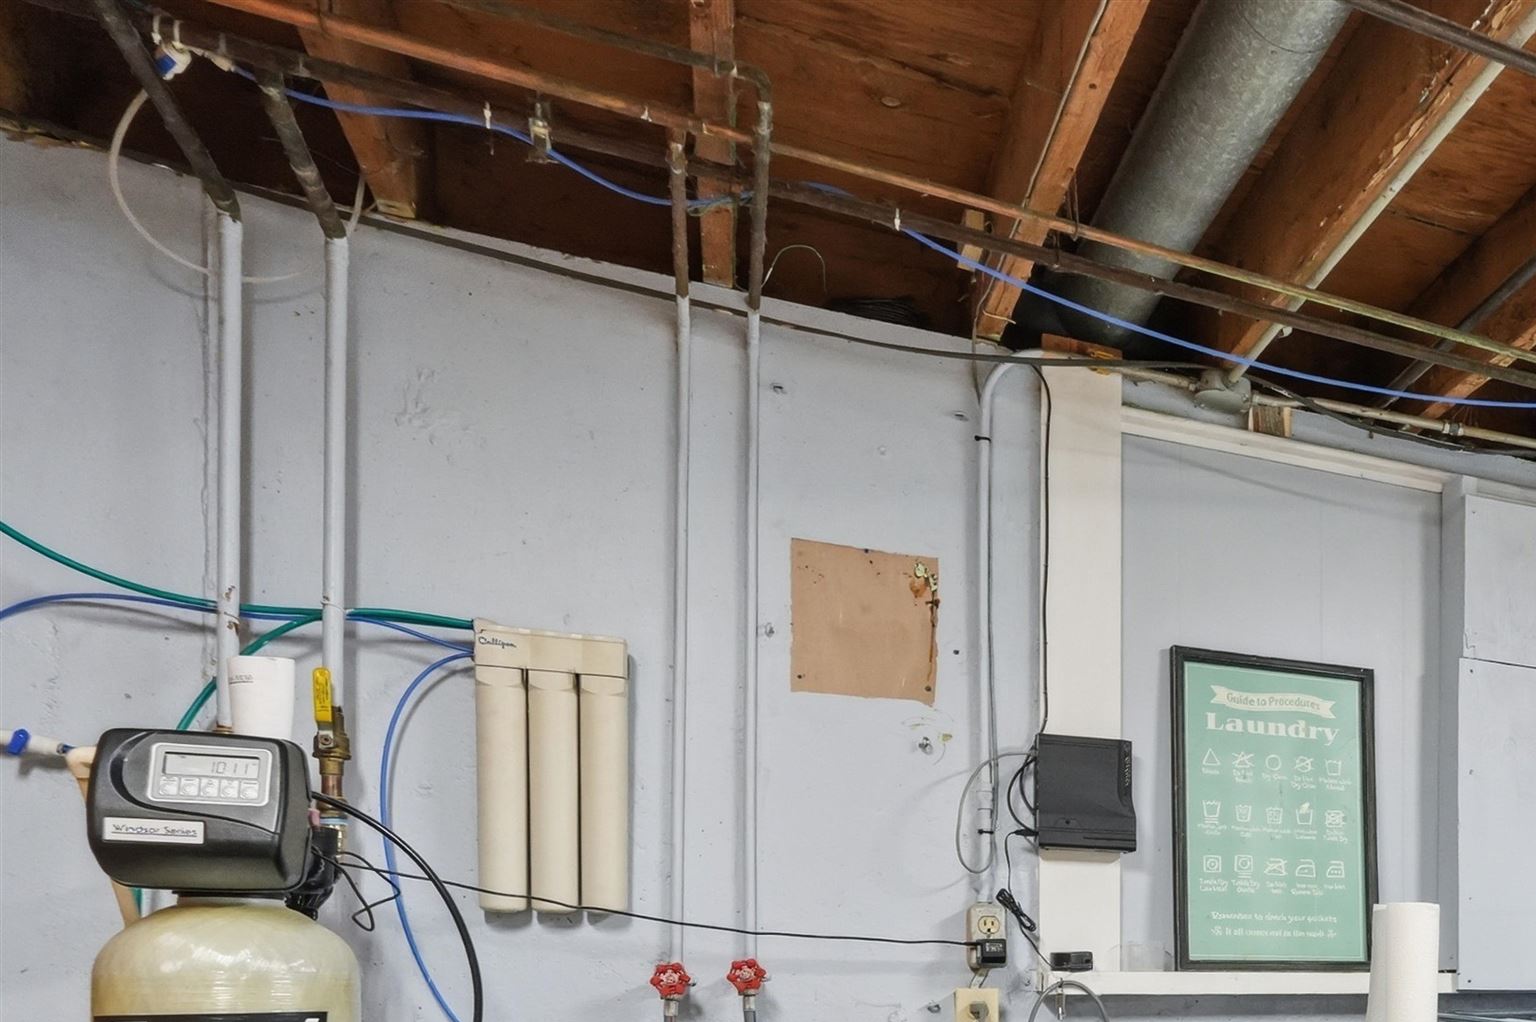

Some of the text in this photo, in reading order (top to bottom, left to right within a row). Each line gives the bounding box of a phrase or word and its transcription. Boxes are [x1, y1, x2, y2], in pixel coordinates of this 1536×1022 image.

[1226, 692, 1320, 711] Guide to Procedures
[1205, 711, 1340, 746] Laundry
